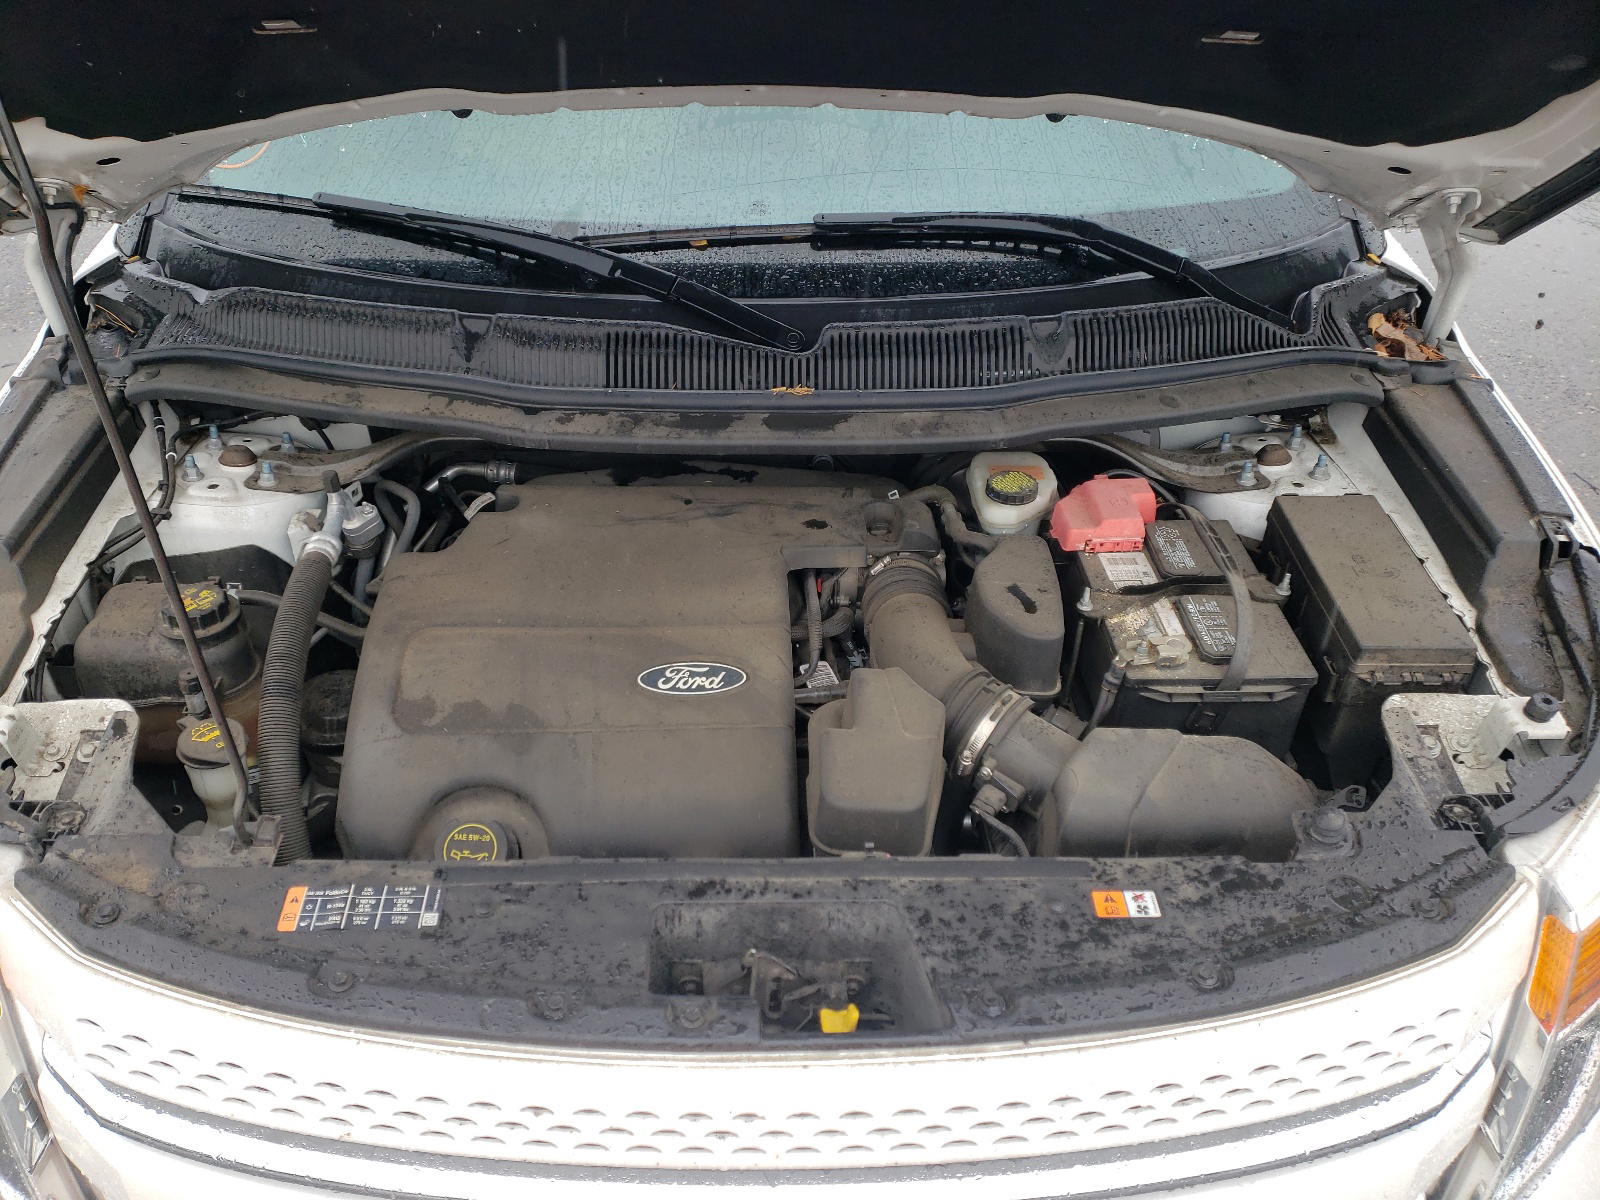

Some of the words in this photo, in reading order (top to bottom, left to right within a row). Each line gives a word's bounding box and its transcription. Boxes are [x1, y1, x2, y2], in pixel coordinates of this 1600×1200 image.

[657, 666, 727, 690] Ford
[453, 833, 468, 841] SAE
[468, 833, 491, 842] 5W-20
